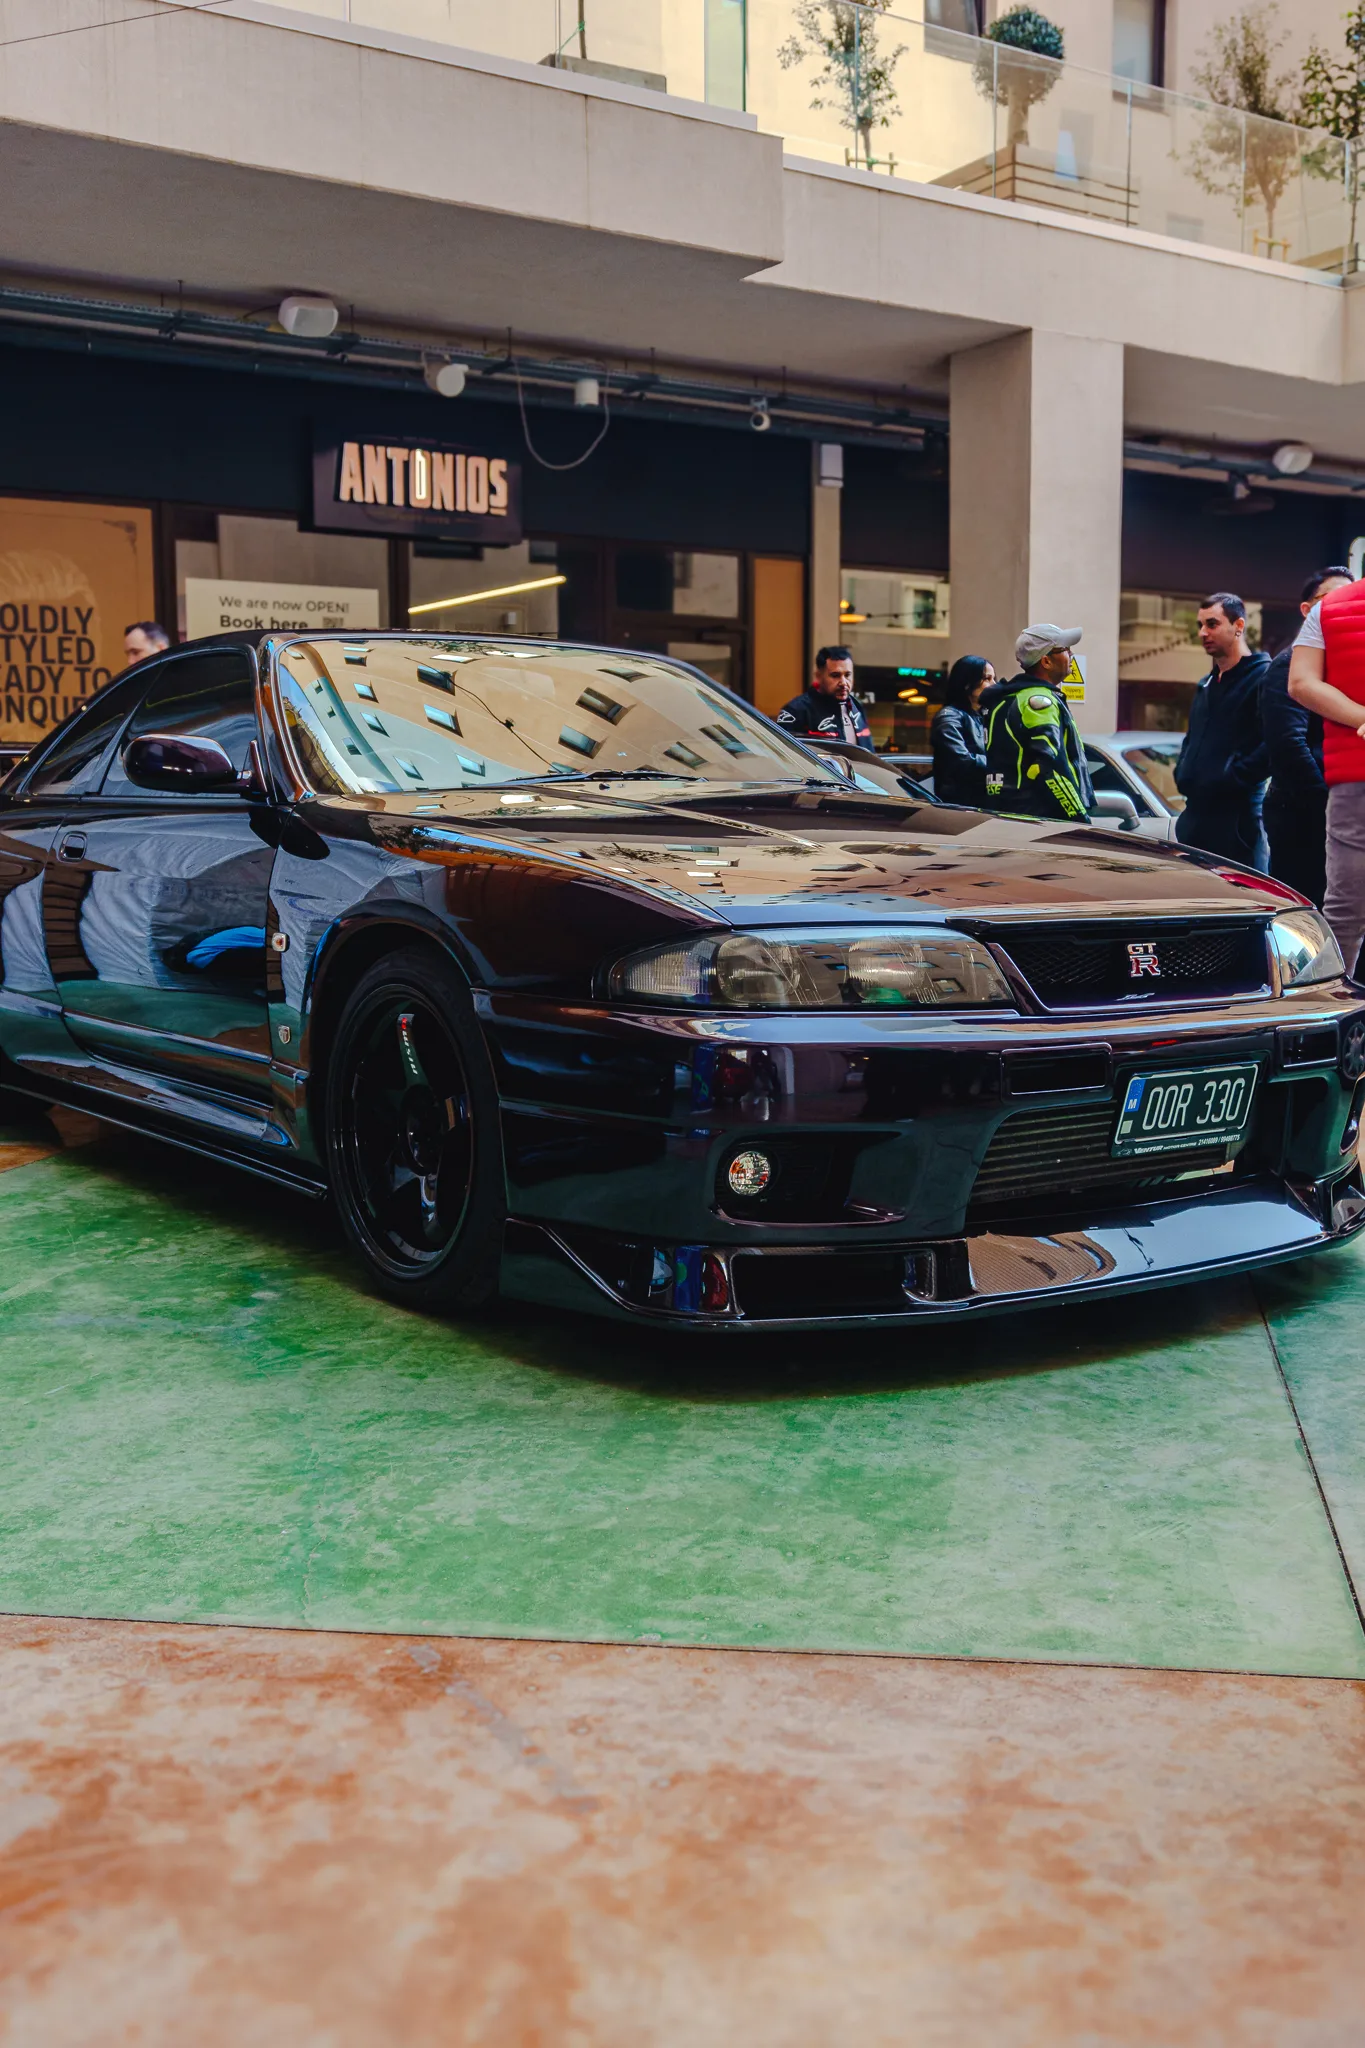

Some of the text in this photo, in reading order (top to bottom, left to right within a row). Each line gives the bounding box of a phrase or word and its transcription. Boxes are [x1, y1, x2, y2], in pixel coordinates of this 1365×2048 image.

[340, 441, 508, 516] ANTONIOS
[0, 603, 94, 635] OLDLY
[219, 596, 350, 614] We are now OPEN!
[220, 614, 309, 630] Book here
[0, 633, 95, 665] TYLED
[0, 664, 112, 695] ADY TO
[0, 694, 88, 729] NQU
[1045, 779, 1078, 818] DAINESE
[1127, 943, 1157, 954] GT
[1130, 955, 1161, 977] R
[1127, 1077, 1246, 1131] M OOR 330
